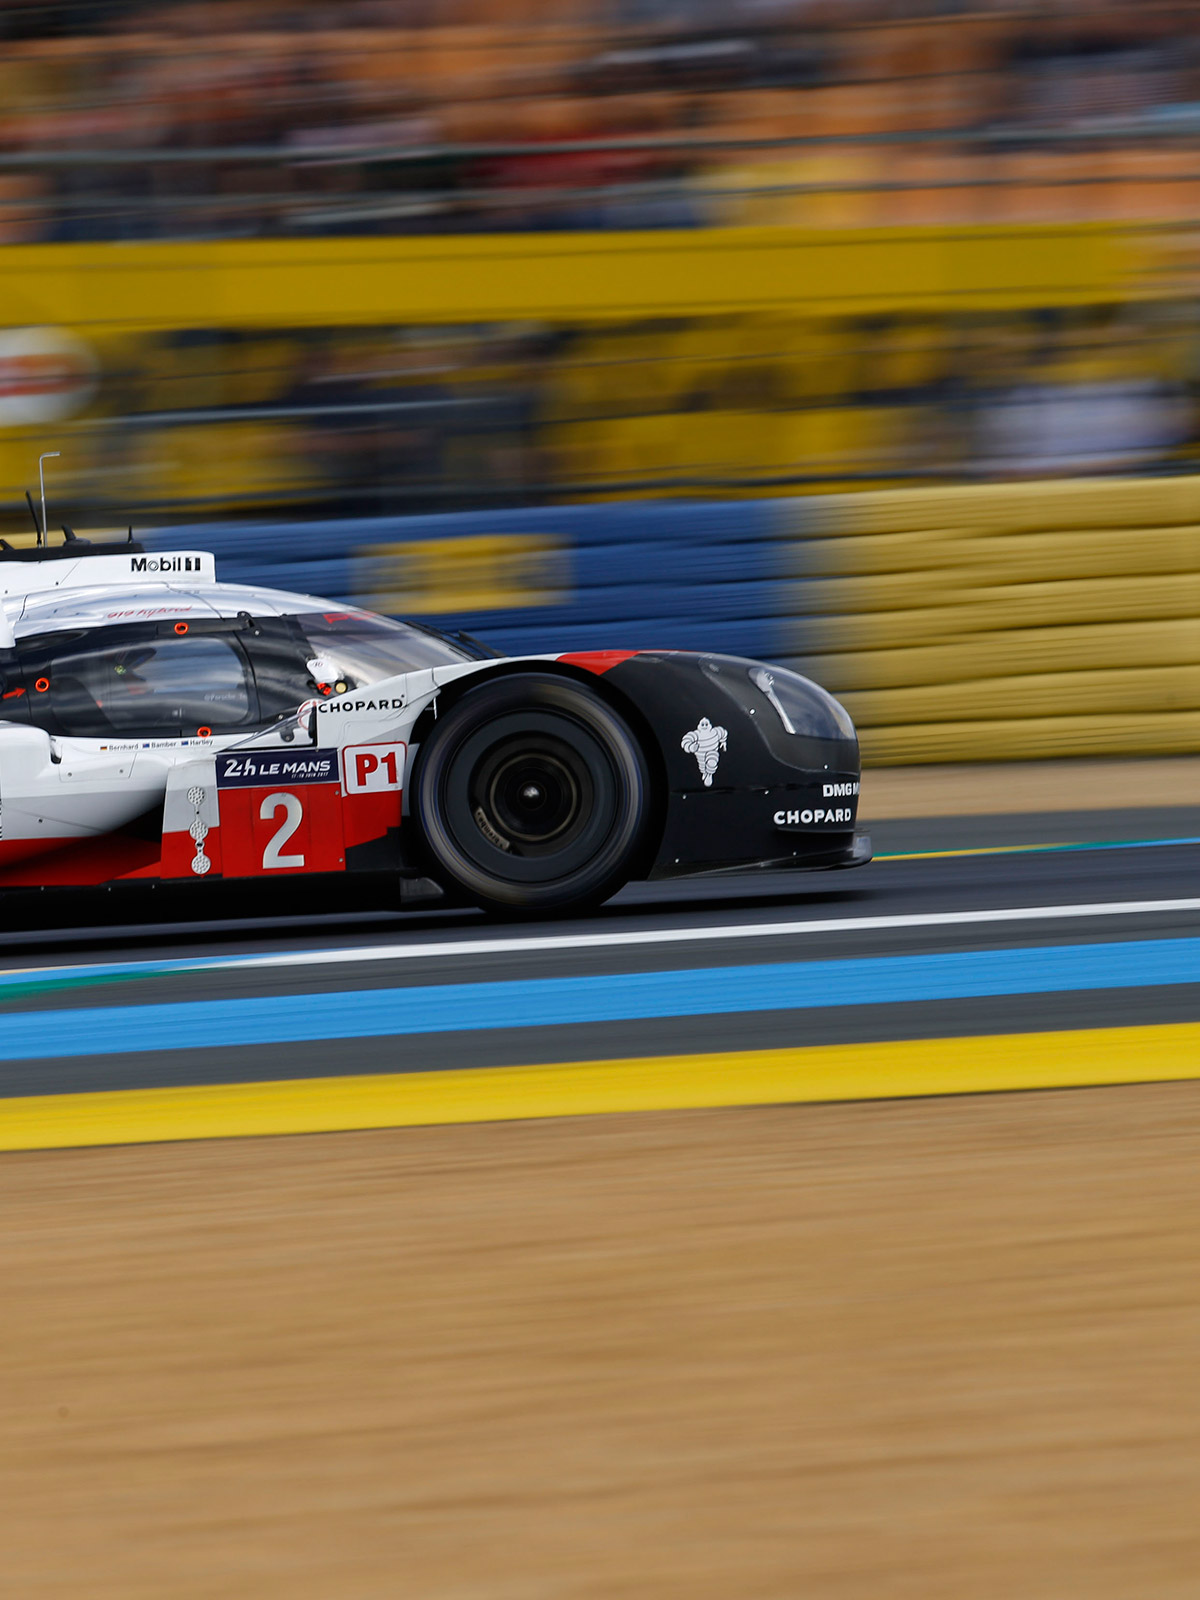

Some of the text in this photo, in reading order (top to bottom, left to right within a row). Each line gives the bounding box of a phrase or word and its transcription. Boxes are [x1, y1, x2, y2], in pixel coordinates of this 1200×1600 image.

[131, 557, 201, 572] Mobil 1
[318, 698, 403, 714] CHOPARD
[224, 758, 331, 777] 24h LE MANS
[355, 752, 397, 786] P1
[822, 782, 852, 797] DMG
[773, 808, 852, 824] CHOPARD
[259, 792, 305, 869] 2
